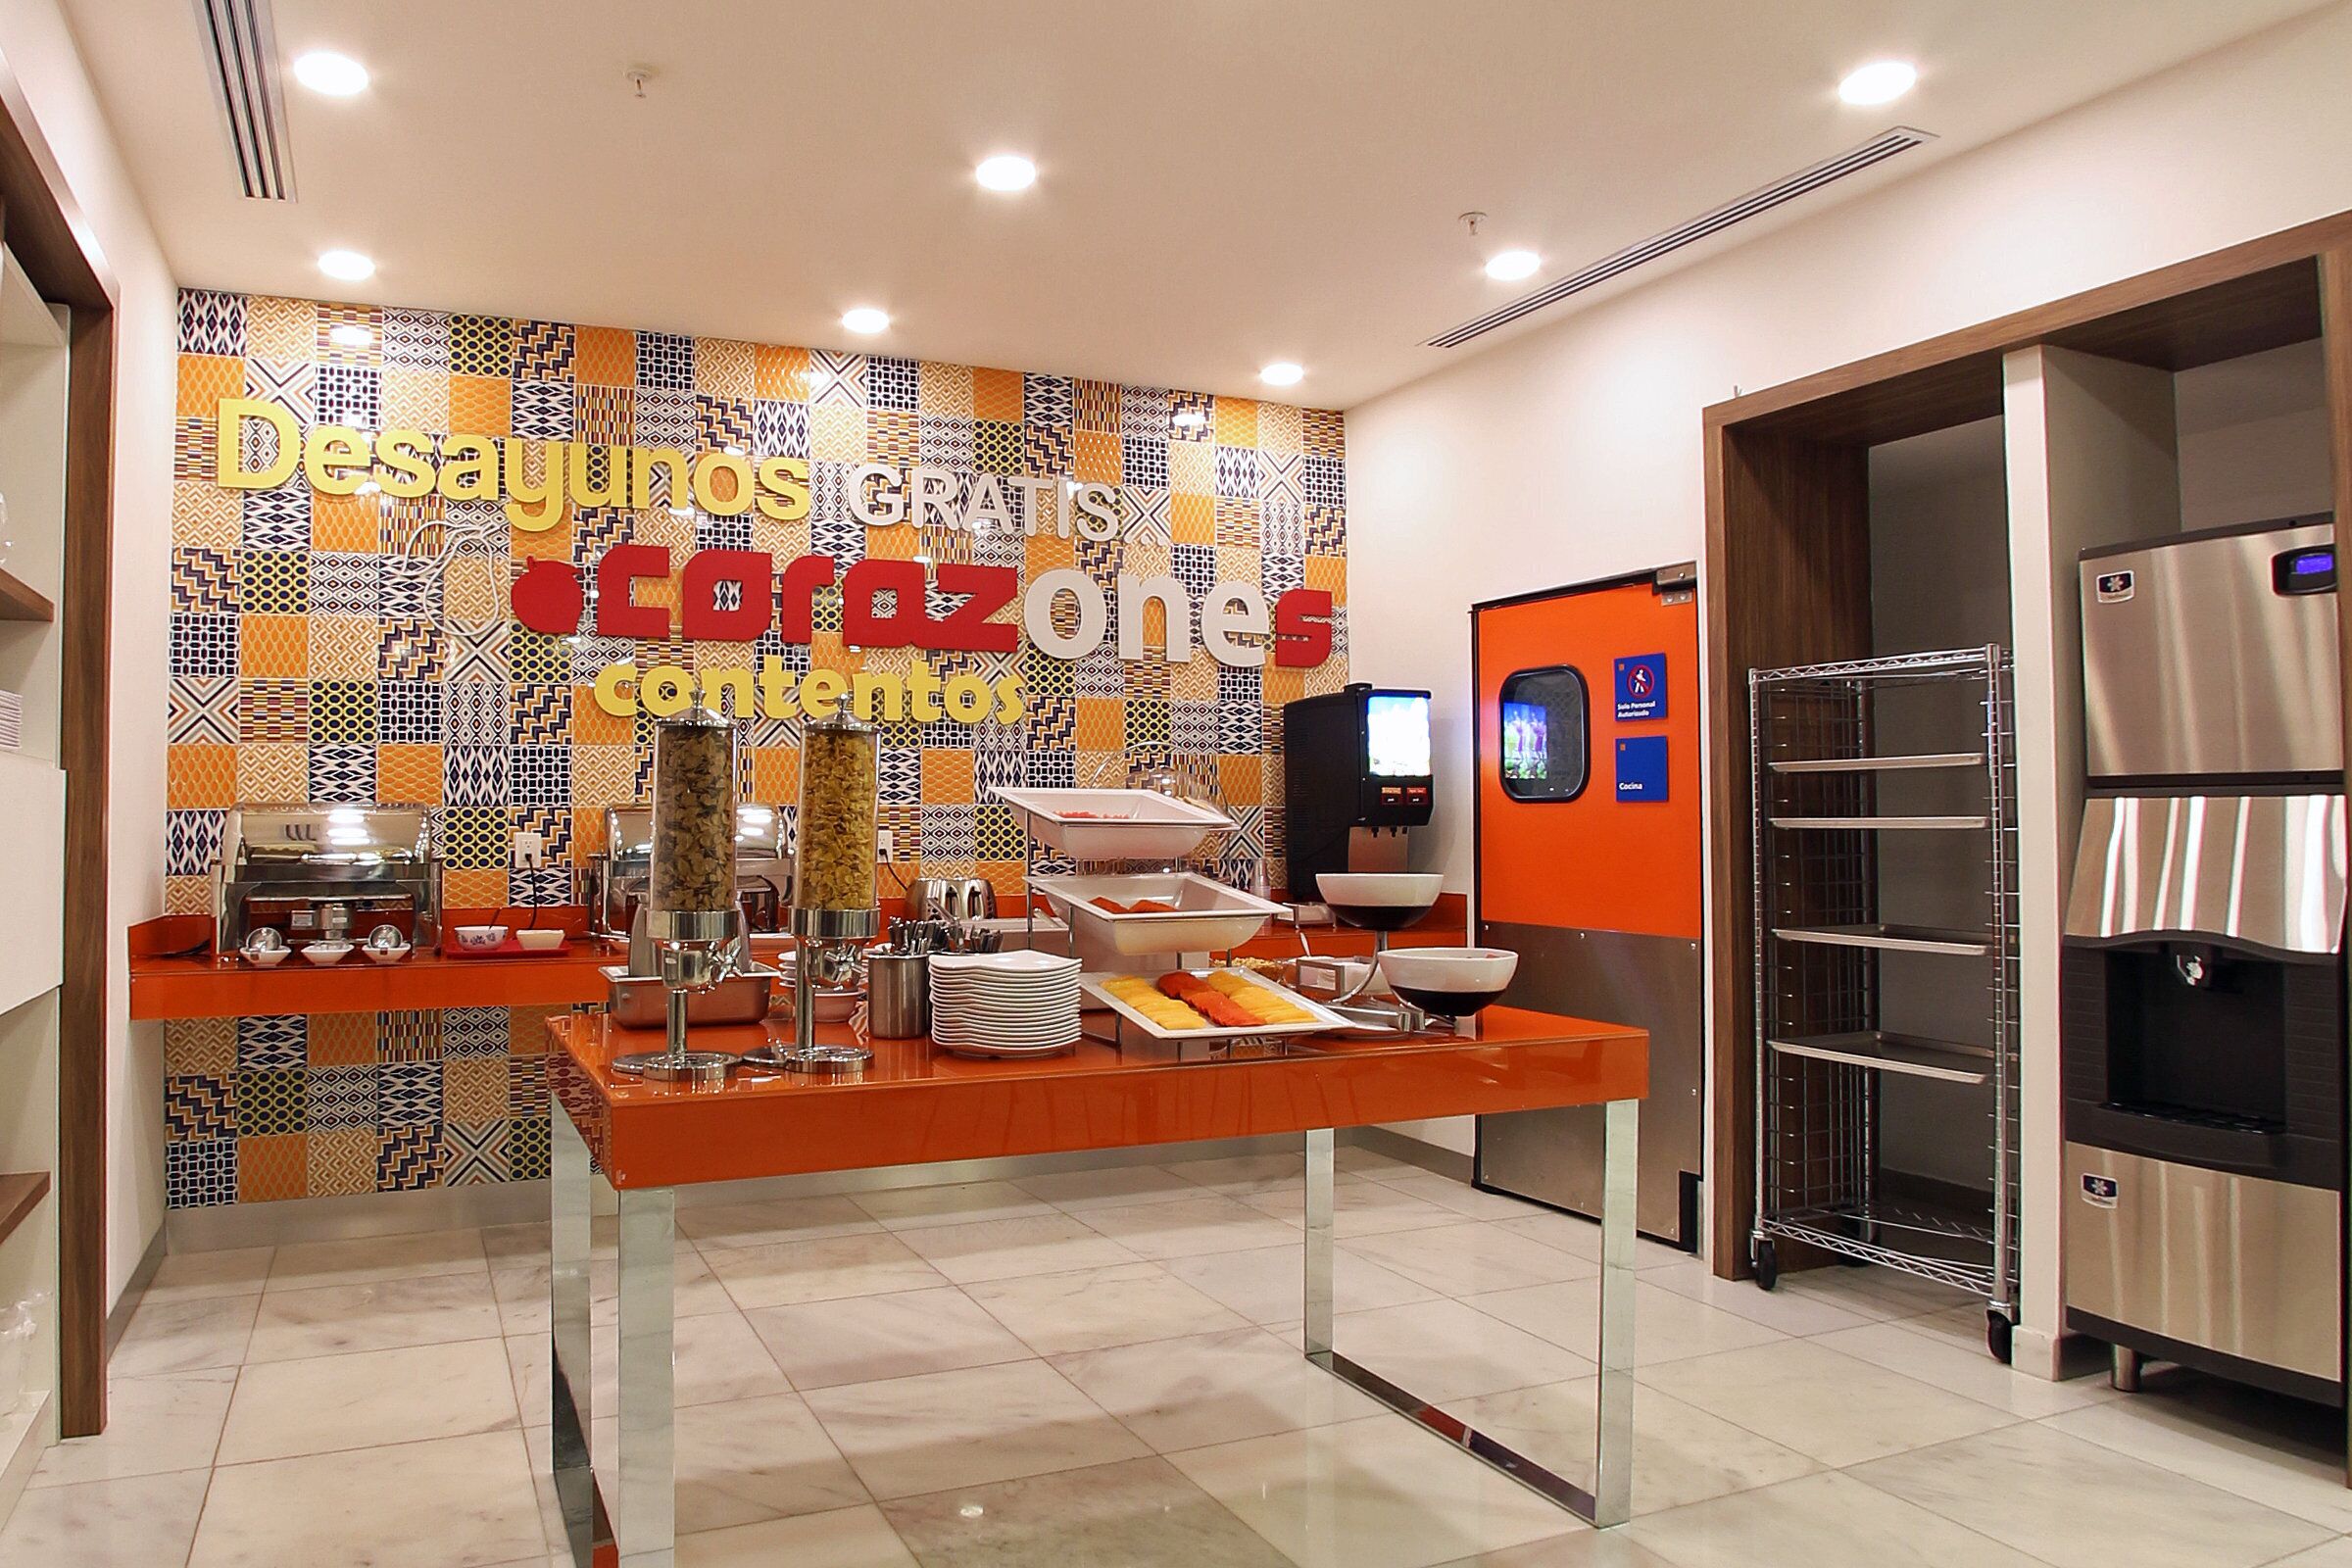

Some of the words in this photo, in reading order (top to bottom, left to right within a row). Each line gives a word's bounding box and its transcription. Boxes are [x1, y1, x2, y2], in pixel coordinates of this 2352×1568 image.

[216, 397, 811, 532] Desayunos
[848, 464, 1123, 543] GRATIS
[597, 544, 1332, 669] corazones
[593, 655, 1025, 724] contentos
